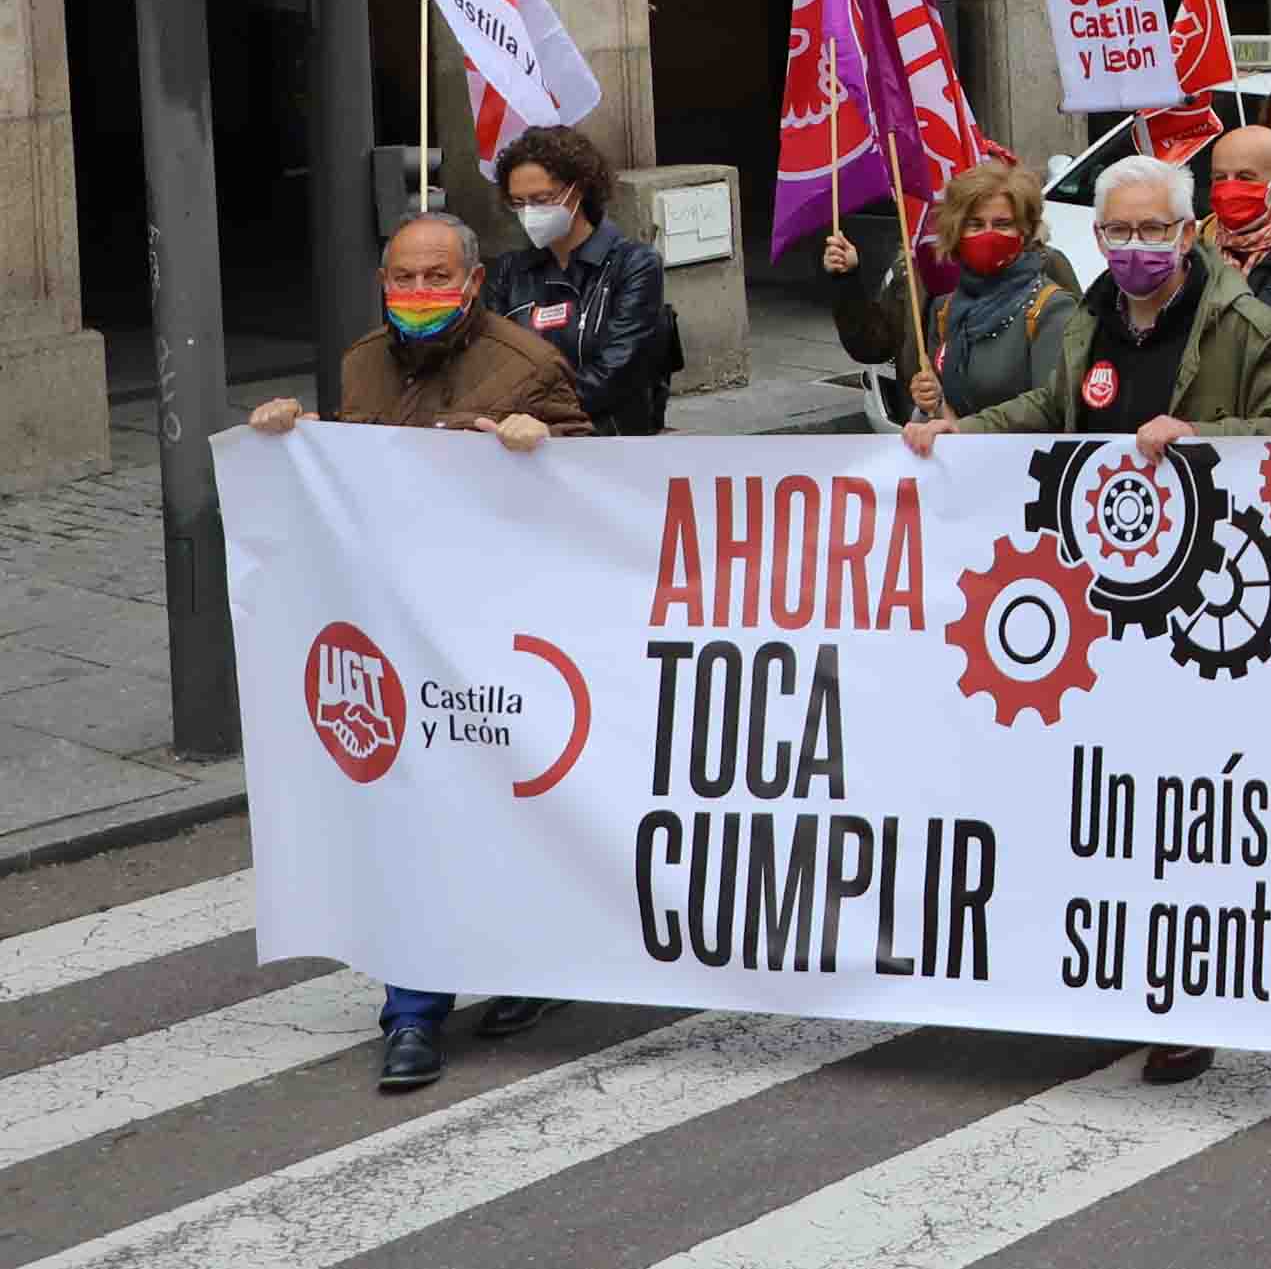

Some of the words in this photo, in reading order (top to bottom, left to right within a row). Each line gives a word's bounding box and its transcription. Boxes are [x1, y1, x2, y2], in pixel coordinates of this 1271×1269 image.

[524, 52, 535, 75] y
[650, 475, 924, 631] AHORA
[318, 643, 388, 709] UGT
[420, 681, 522, 714] Castilla
[648, 641, 845, 800] TOCA
[422, 723, 437, 749] y
[450, 715, 510, 746] León
[1071, 746, 1134, 858] Un
[1155, 753, 1267, 879] país
[636, 811, 996, 981] CUMPLIR
[1063, 898, 1126, 989] su
